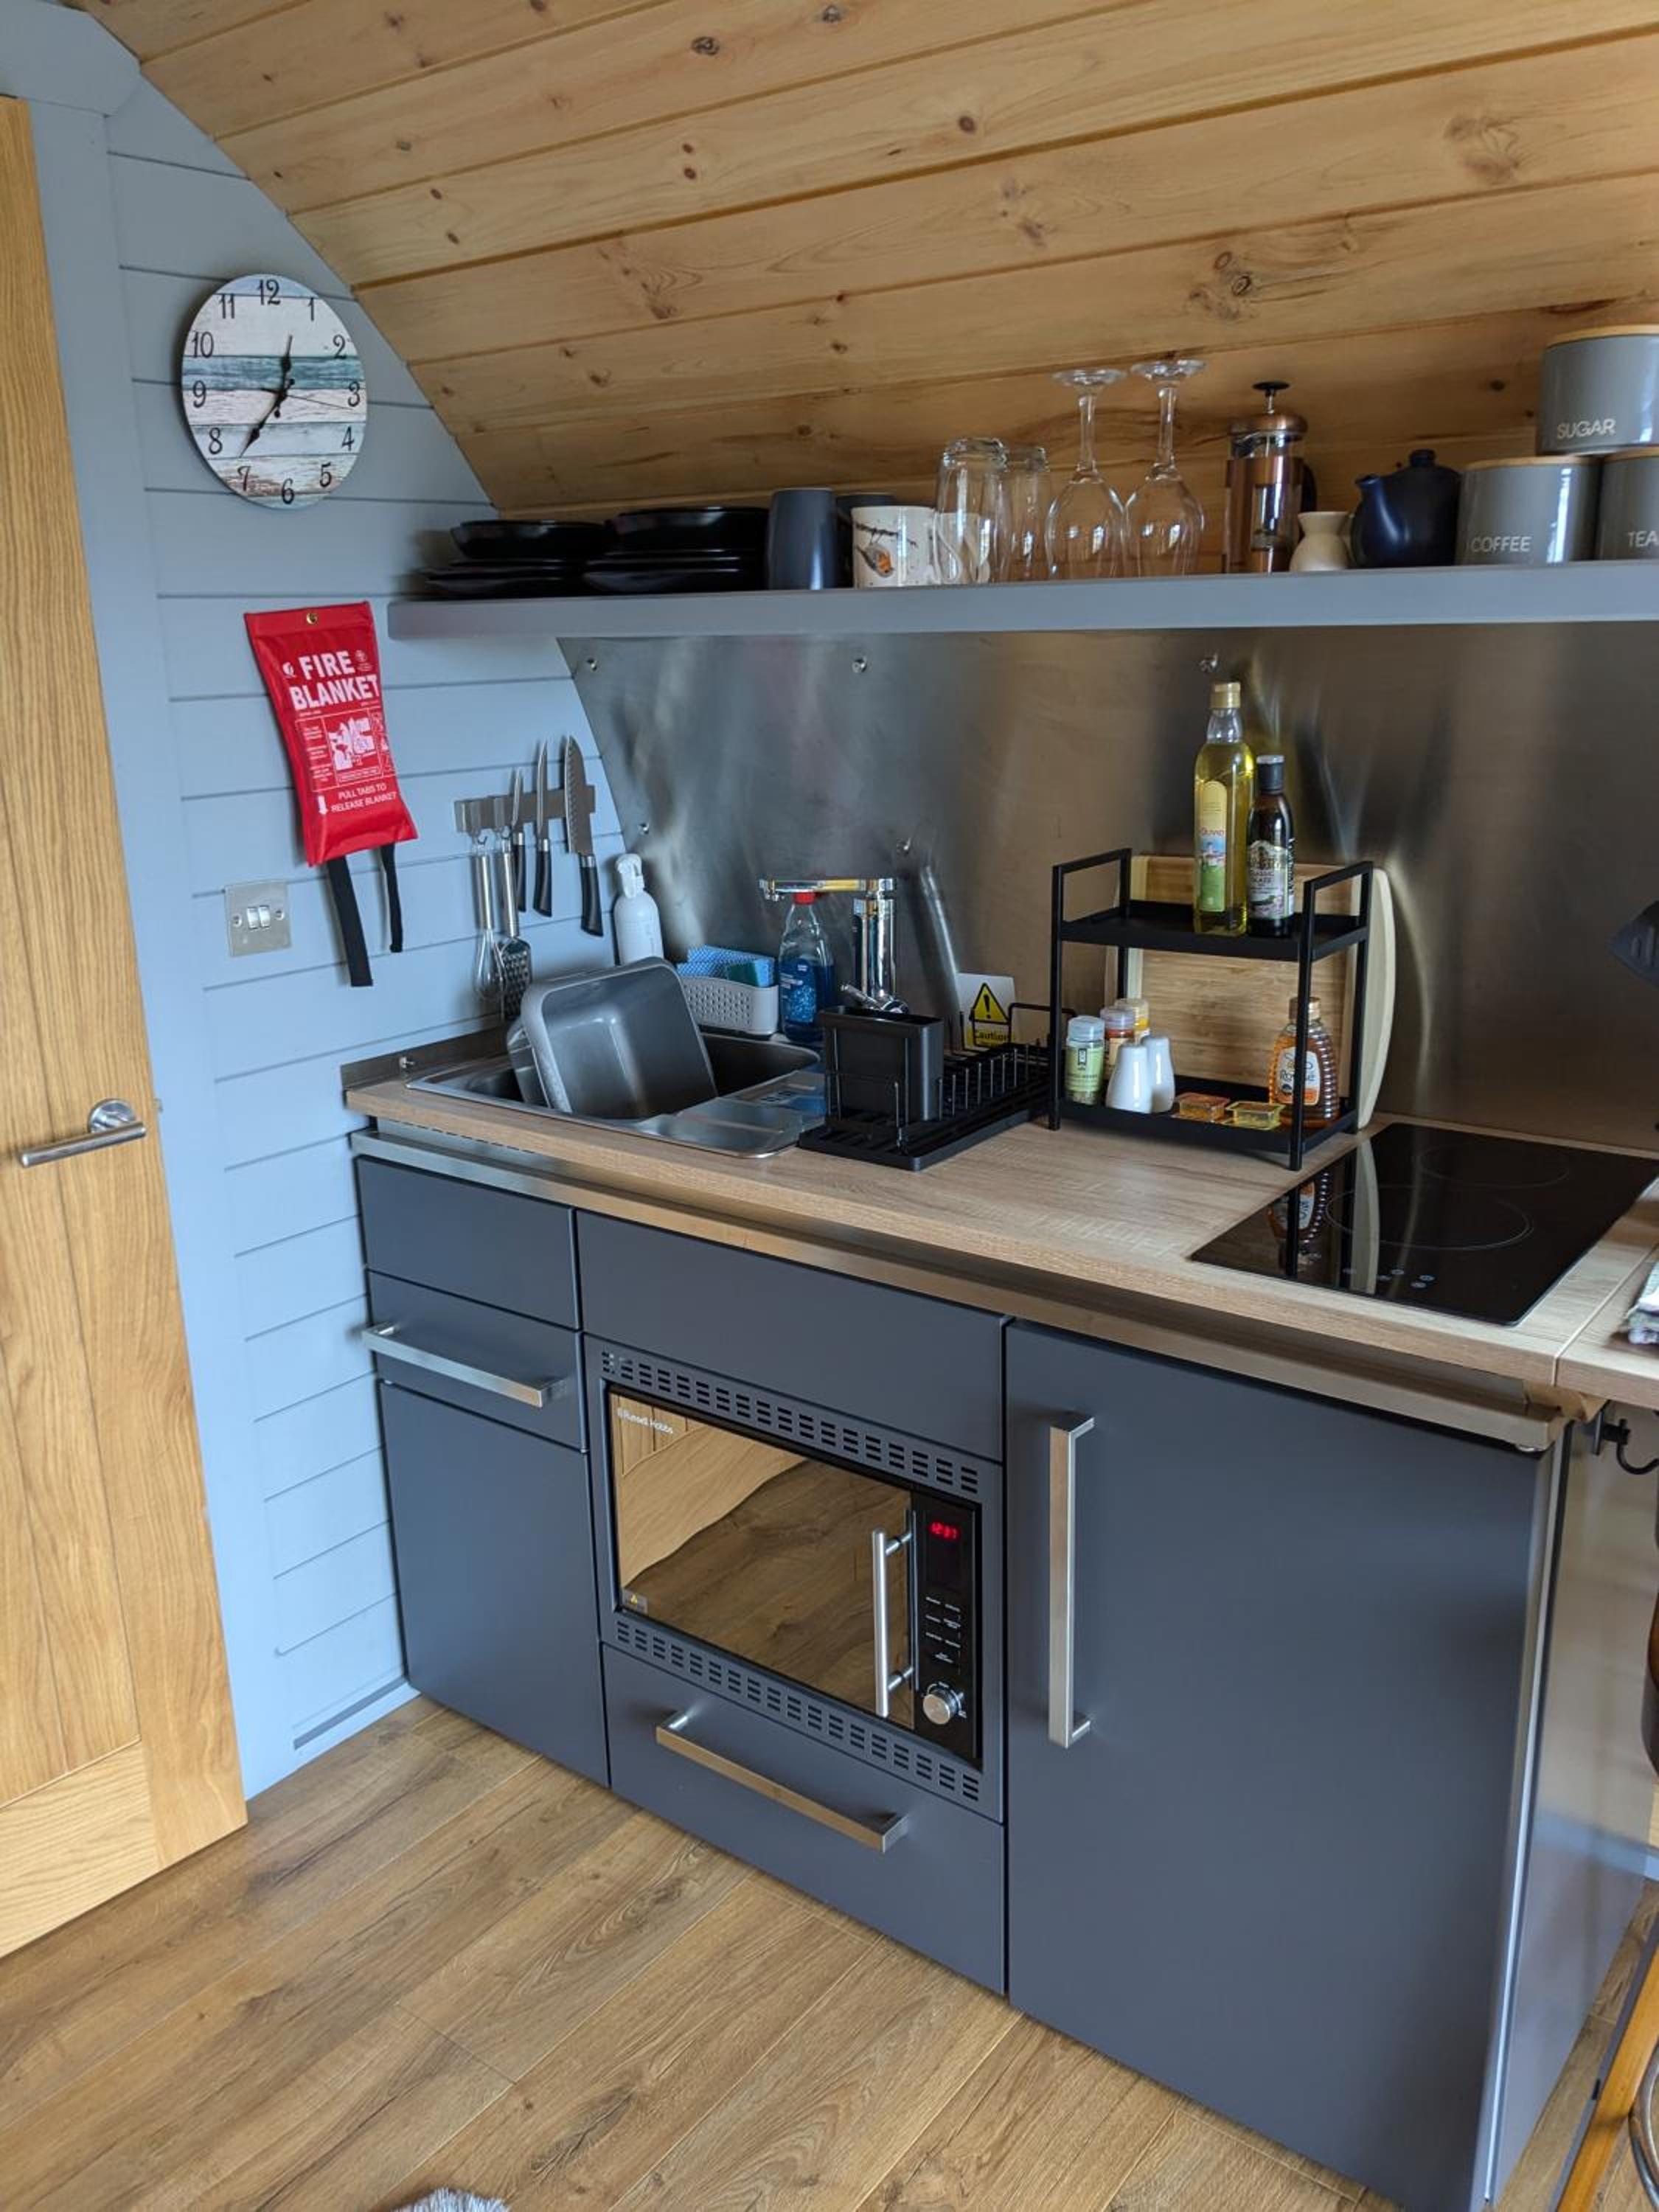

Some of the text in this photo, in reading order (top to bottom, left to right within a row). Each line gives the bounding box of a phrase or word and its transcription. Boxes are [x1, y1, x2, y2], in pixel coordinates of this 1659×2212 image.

[258, 279, 280, 305] 12
[218, 294, 235, 319] 11
[307, 298, 315, 321] 1
[191, 332, 214, 358] 10
[333, 335, 347, 360] 2
[192, 380, 206, 408] 9
[347, 381, 361, 407] 3
[209, 427, 223, 455] 8
[341, 425, 355, 451] 4
[1557, 418, 1617, 439] SUGAR
[237, 466, 251, 491] 7
[319, 462, 332, 487] 5
[281, 478, 294, 504] 6
[1470, 535, 1532, 553] COFFEE
[1627, 529, 1659, 548] TEA
[299, 650, 355, 680] FIRE
[289, 674, 380, 712] BLANKET
[331, 791, 397, 813] RELEASE BLANKET
[338, 782, 387, 801] PULL TABS TO
